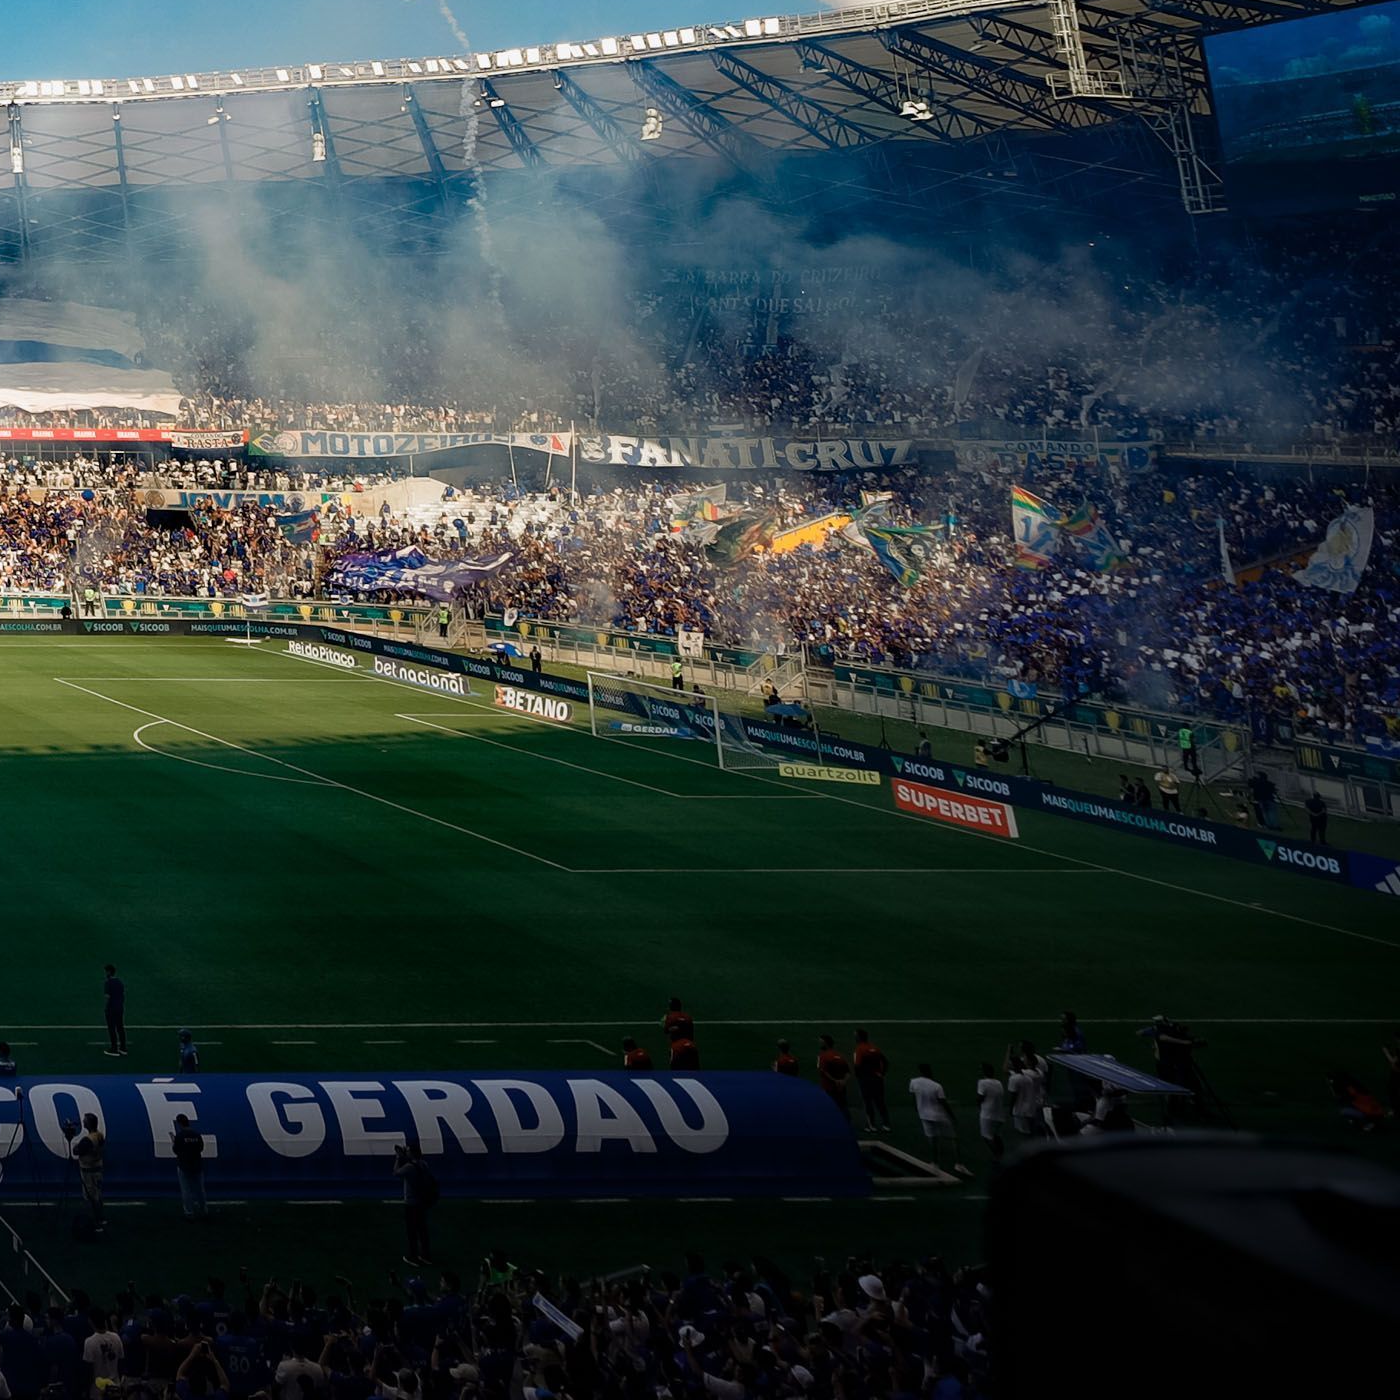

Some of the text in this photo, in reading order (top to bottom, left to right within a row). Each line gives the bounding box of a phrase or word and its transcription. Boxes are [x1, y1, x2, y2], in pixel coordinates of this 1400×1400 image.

[187, 438, 229, 449] RASTA
[1004, 442, 1095, 453] COMANDO
[93, 622, 124, 632] SICOOB
[139, 622, 170, 632] SICOOB
[468, 662, 491, 676] SICOOB
[500, 669, 525, 684] SICOOB
[504, 686, 569, 721] BETANO
[651, 703, 680, 720] SICOOB
[633, 725, 678, 735] GERDAU
[783, 764, 877, 784] quartzolit
[904, 760, 945, 782] SICOOB
[966, 774, 1011, 797] SICOOB
[897, 785, 1003, 827] SUPERBET
[1041, 791, 1217, 846] MAISQUEUMAESCOLHA.COM.BR
[1276, 845, 1342, 875] SICOOB
[246, 1078, 730, 1159] GERDAU
[229, 1354, 250, 1374] 80
